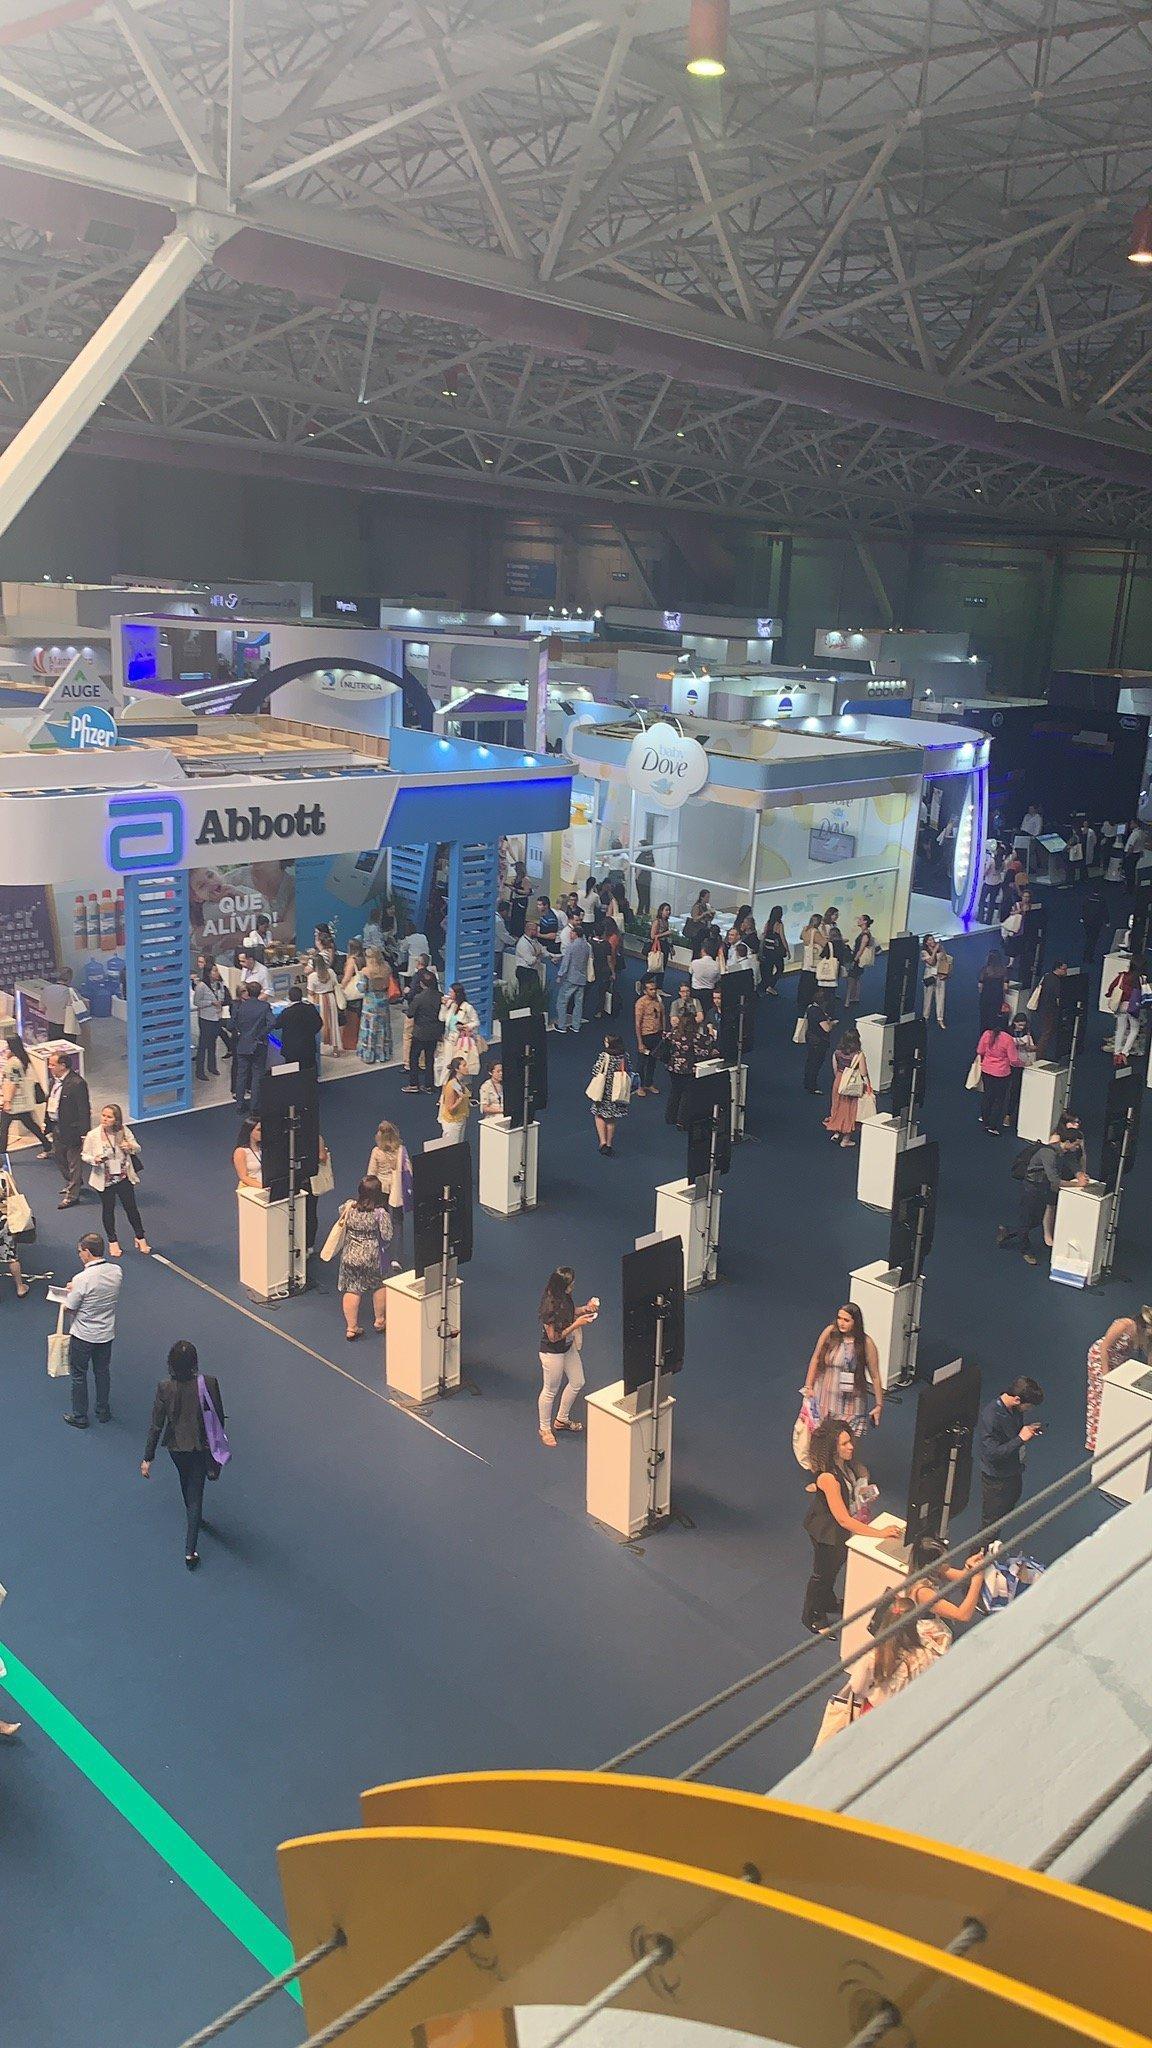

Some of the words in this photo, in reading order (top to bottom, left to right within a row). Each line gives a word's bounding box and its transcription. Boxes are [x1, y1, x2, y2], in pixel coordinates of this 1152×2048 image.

[61, 685, 101, 698] AUGE
[342, 681, 383, 691] NUTRICIA
[70, 713, 114, 748] Pfizer
[641, 747, 688, 777] Dove
[195, 803, 326, 846] Abbott
[219, 893, 263, 914] QUE
